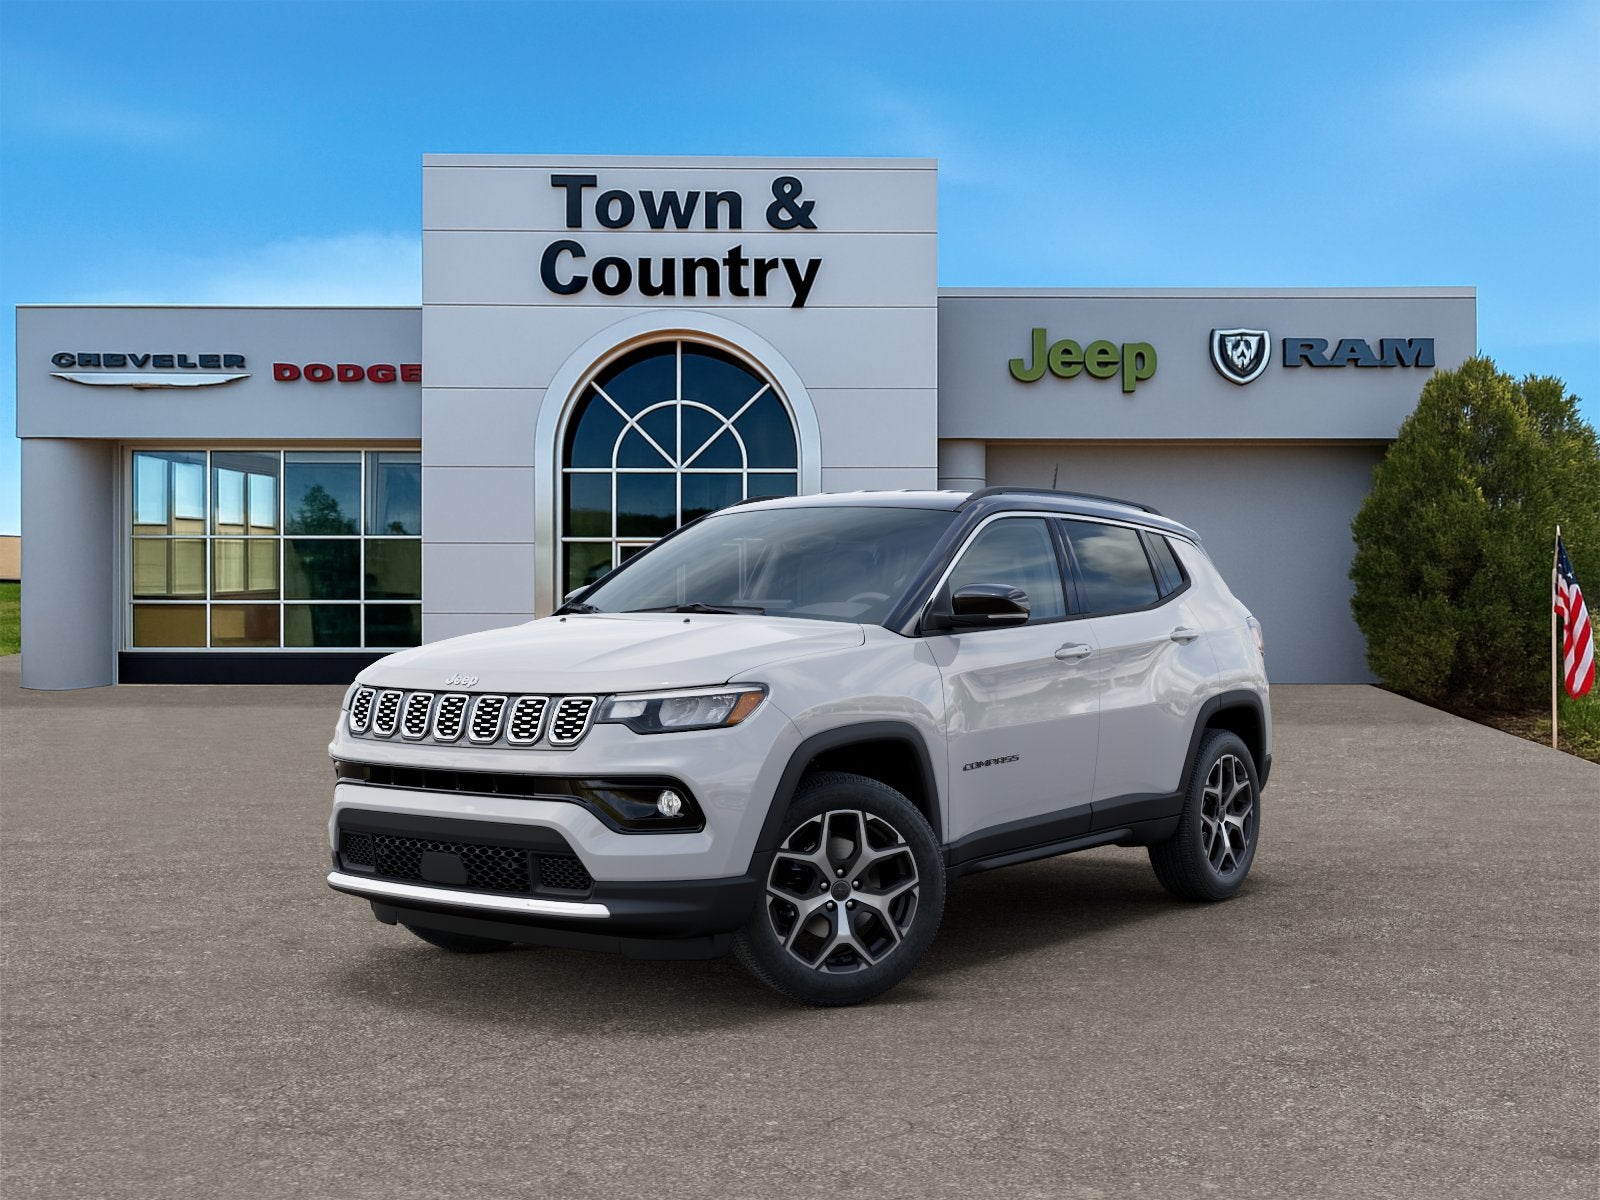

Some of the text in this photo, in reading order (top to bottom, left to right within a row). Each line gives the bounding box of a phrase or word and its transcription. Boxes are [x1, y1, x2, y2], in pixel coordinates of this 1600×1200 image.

[550, 174, 818, 230] Town &
[540, 239, 822, 308] Country
[1008, 328, 1158, 393] Jeep
[1282, 337, 1435, 368] RAM
[272, 362, 422, 383] DODGE
[445, 672, 480, 688] Jeep
[962, 754, 1020, 772] COMPASS
